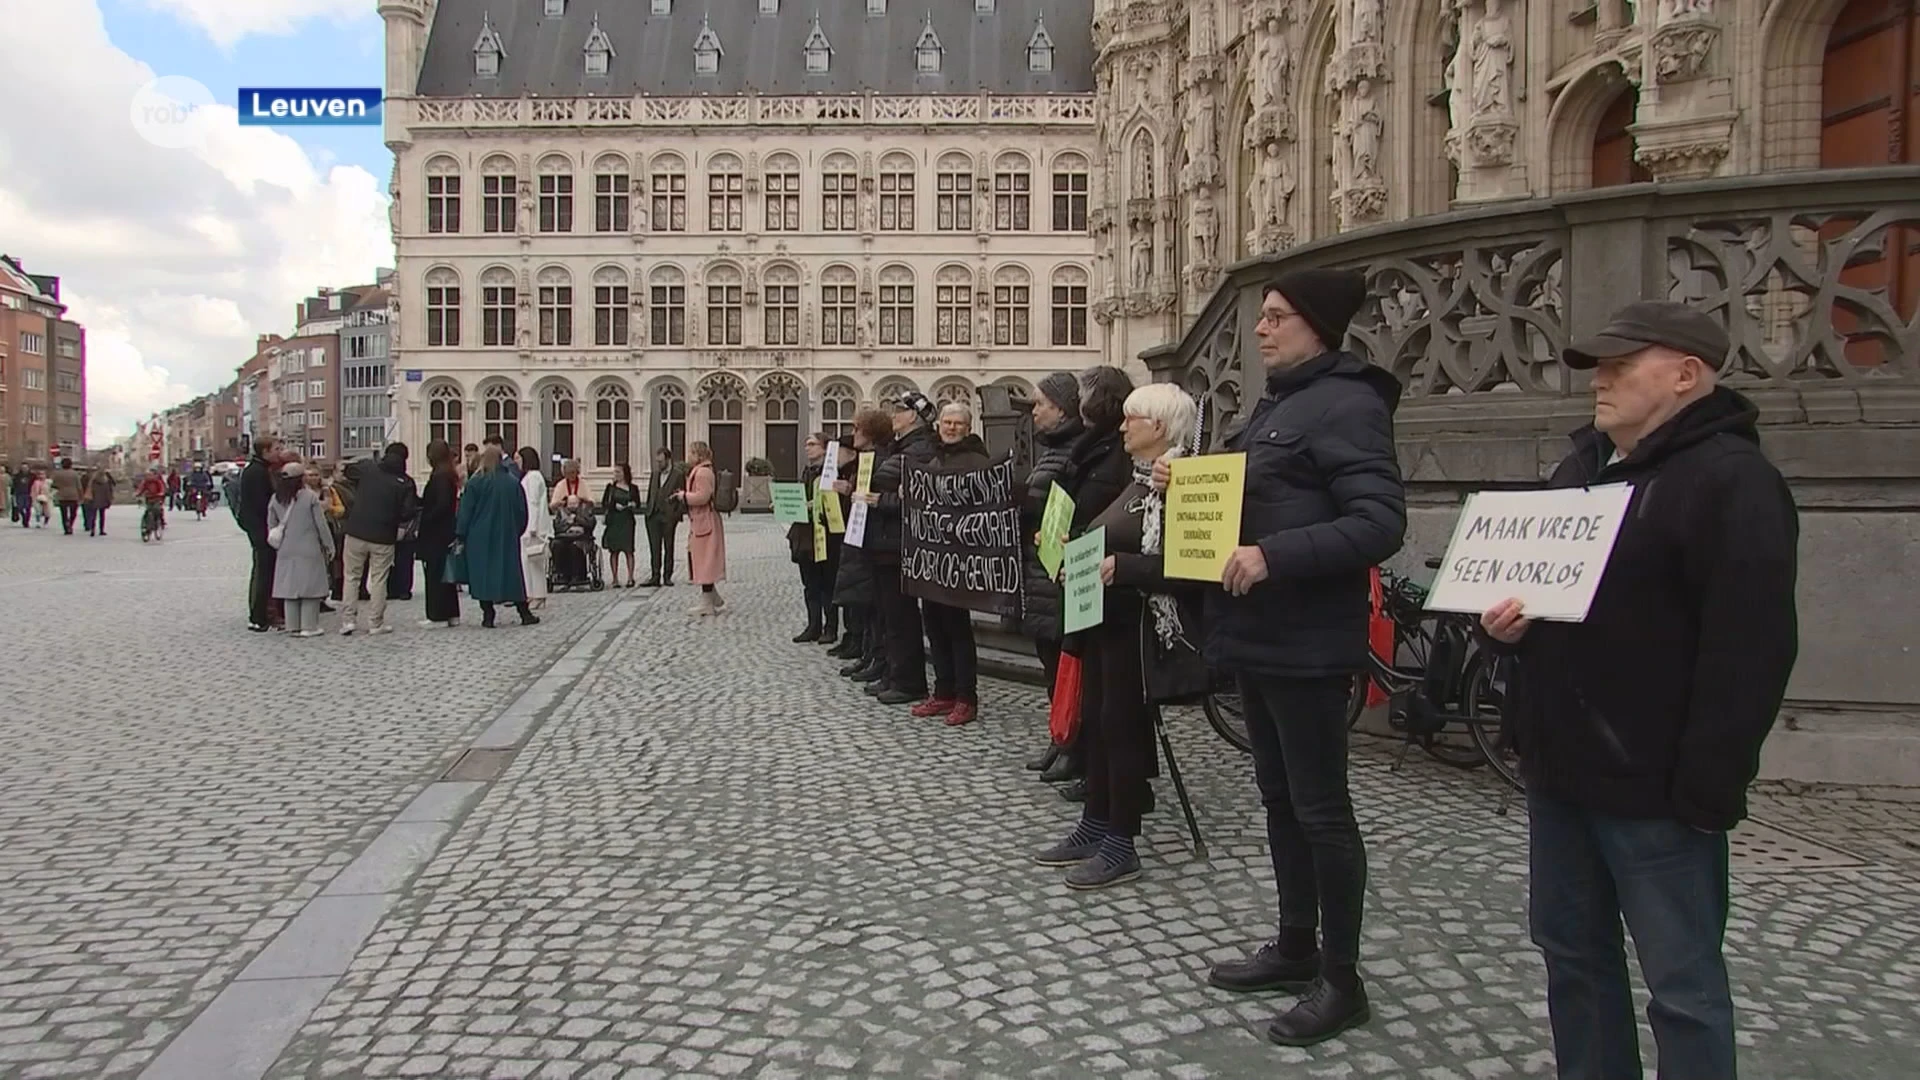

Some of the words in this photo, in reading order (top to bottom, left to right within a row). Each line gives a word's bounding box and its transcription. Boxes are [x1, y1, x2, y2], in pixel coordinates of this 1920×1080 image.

[1208, 492, 1220, 503] EEN
[956, 508, 1017, 548] VERDRIET
[1215, 511, 1224, 521] DE
[1464, 515, 1535, 541] MAAK
[1537, 514, 1606, 541] VREDE
[964, 553, 1019, 594] GEWELD
[1450, 556, 1504, 584] GEEN
[1505, 561, 1585, 589] OORLOG
